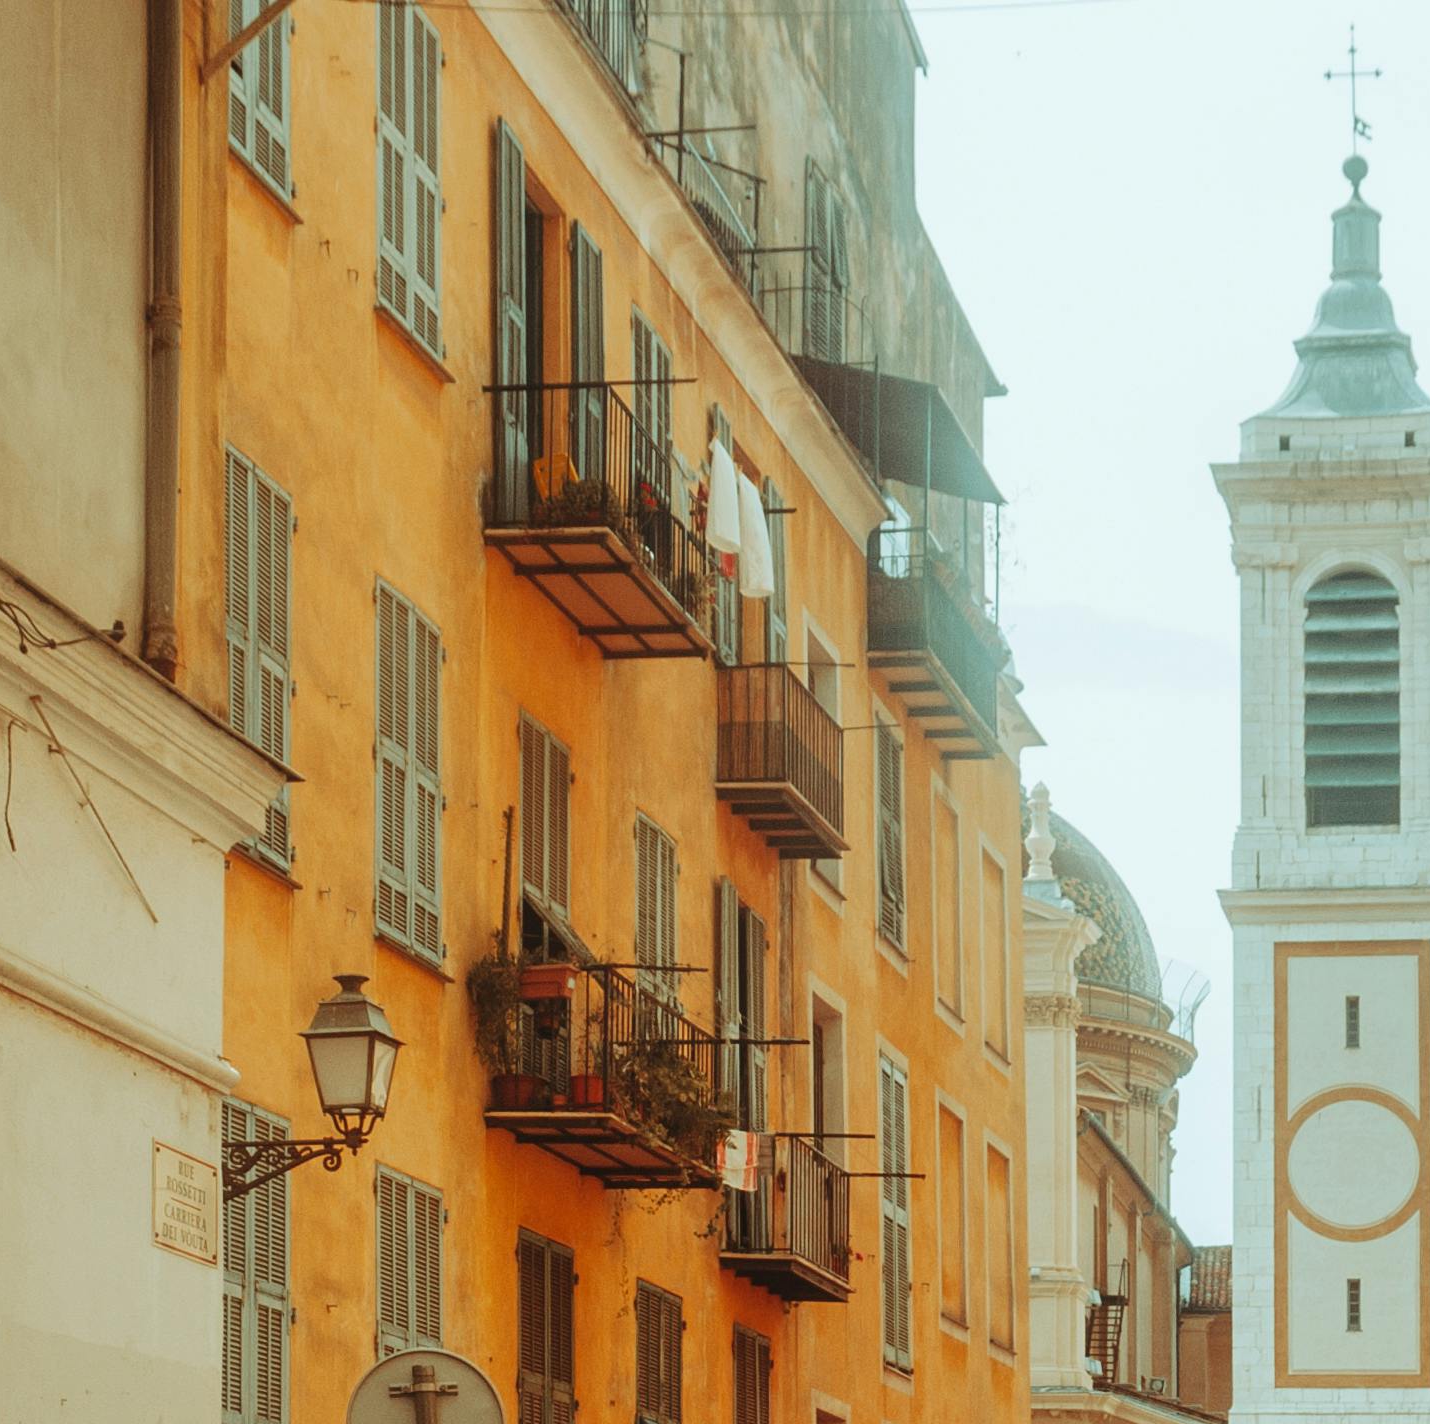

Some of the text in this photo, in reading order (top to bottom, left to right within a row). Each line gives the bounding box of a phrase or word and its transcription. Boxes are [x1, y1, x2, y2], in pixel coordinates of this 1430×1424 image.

[178, 1161, 195, 1181] RUE
[166, 1175, 206, 1206] ROSSETTI
[164, 1202, 207, 1233] CARRIERA
[162, 1222, 177, 1241] DEI
